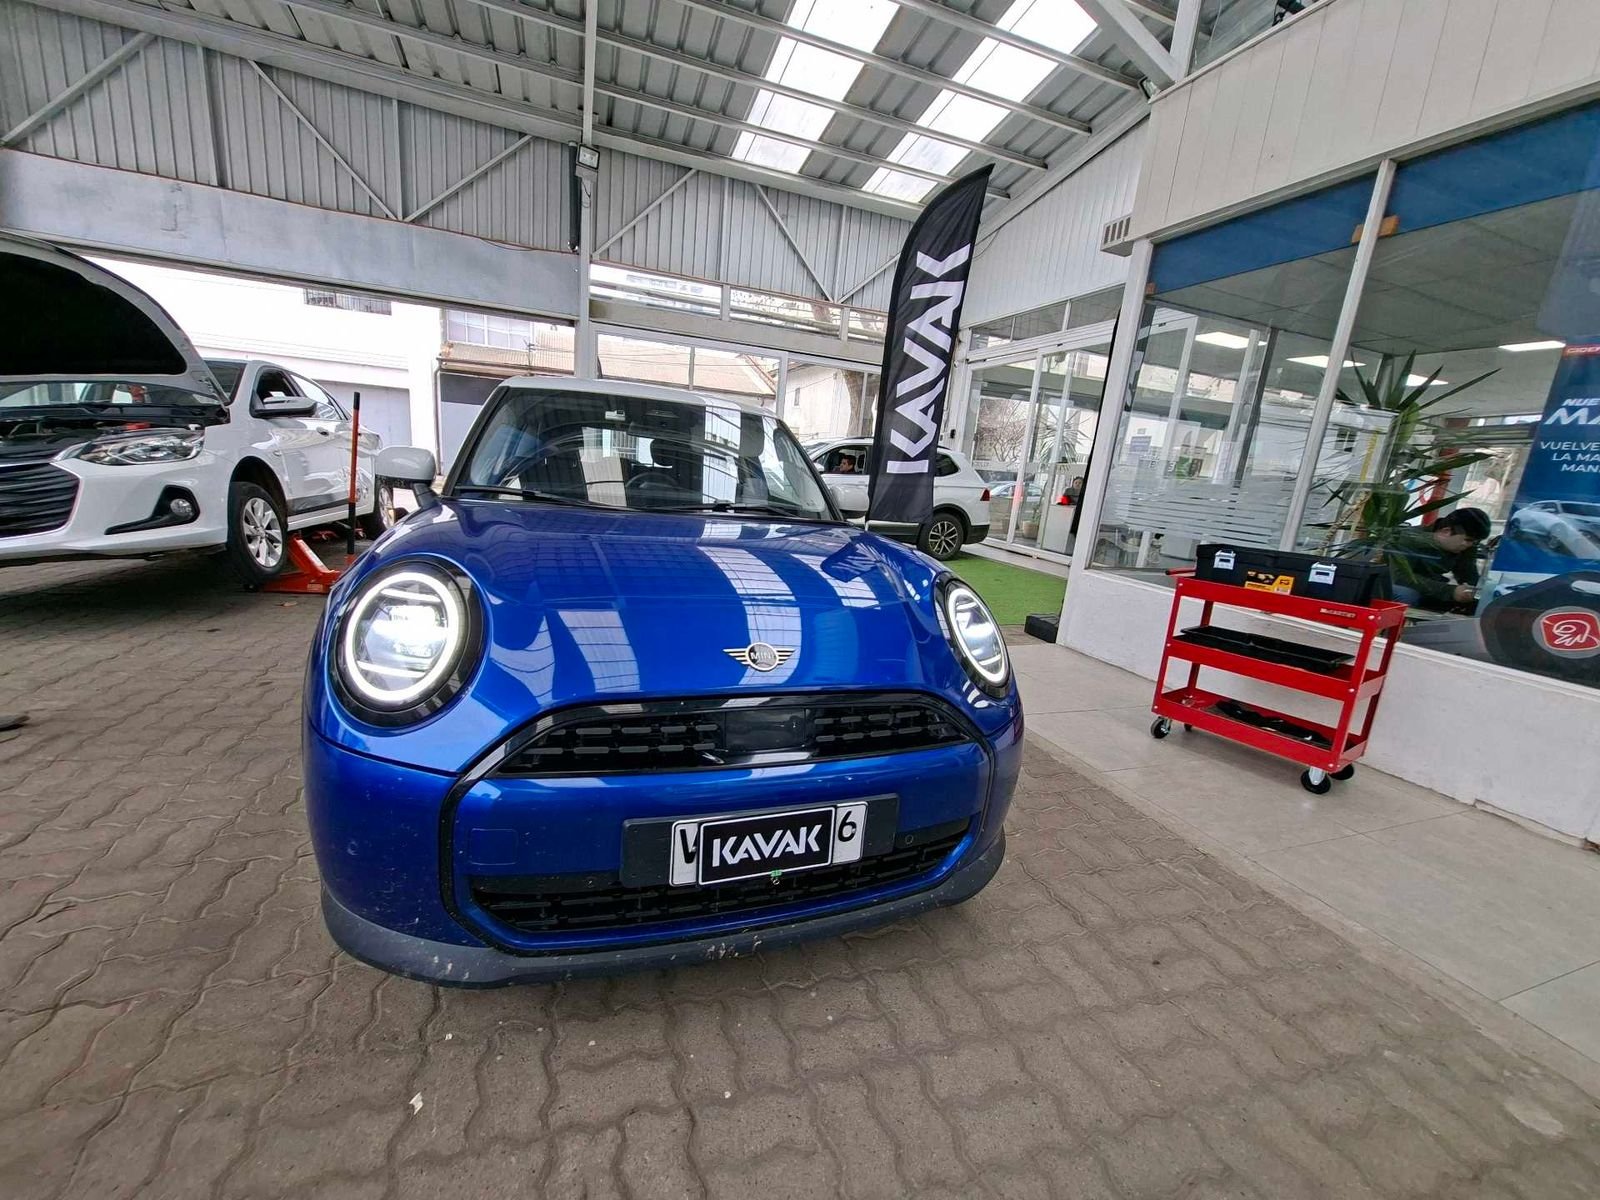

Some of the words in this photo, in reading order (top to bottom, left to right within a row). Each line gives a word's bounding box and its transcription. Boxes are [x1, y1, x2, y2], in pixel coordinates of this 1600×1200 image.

[886, 243, 971, 473] KAVAK
[1540, 441, 1600, 451] VUELVE
[1552, 452, 1572, 461] LA
[1560, 463, 1600, 473] MAN
[749, 651, 776, 661] MINI
[838, 810, 857, 842] 6
[712, 824, 823, 867] KAVAK
